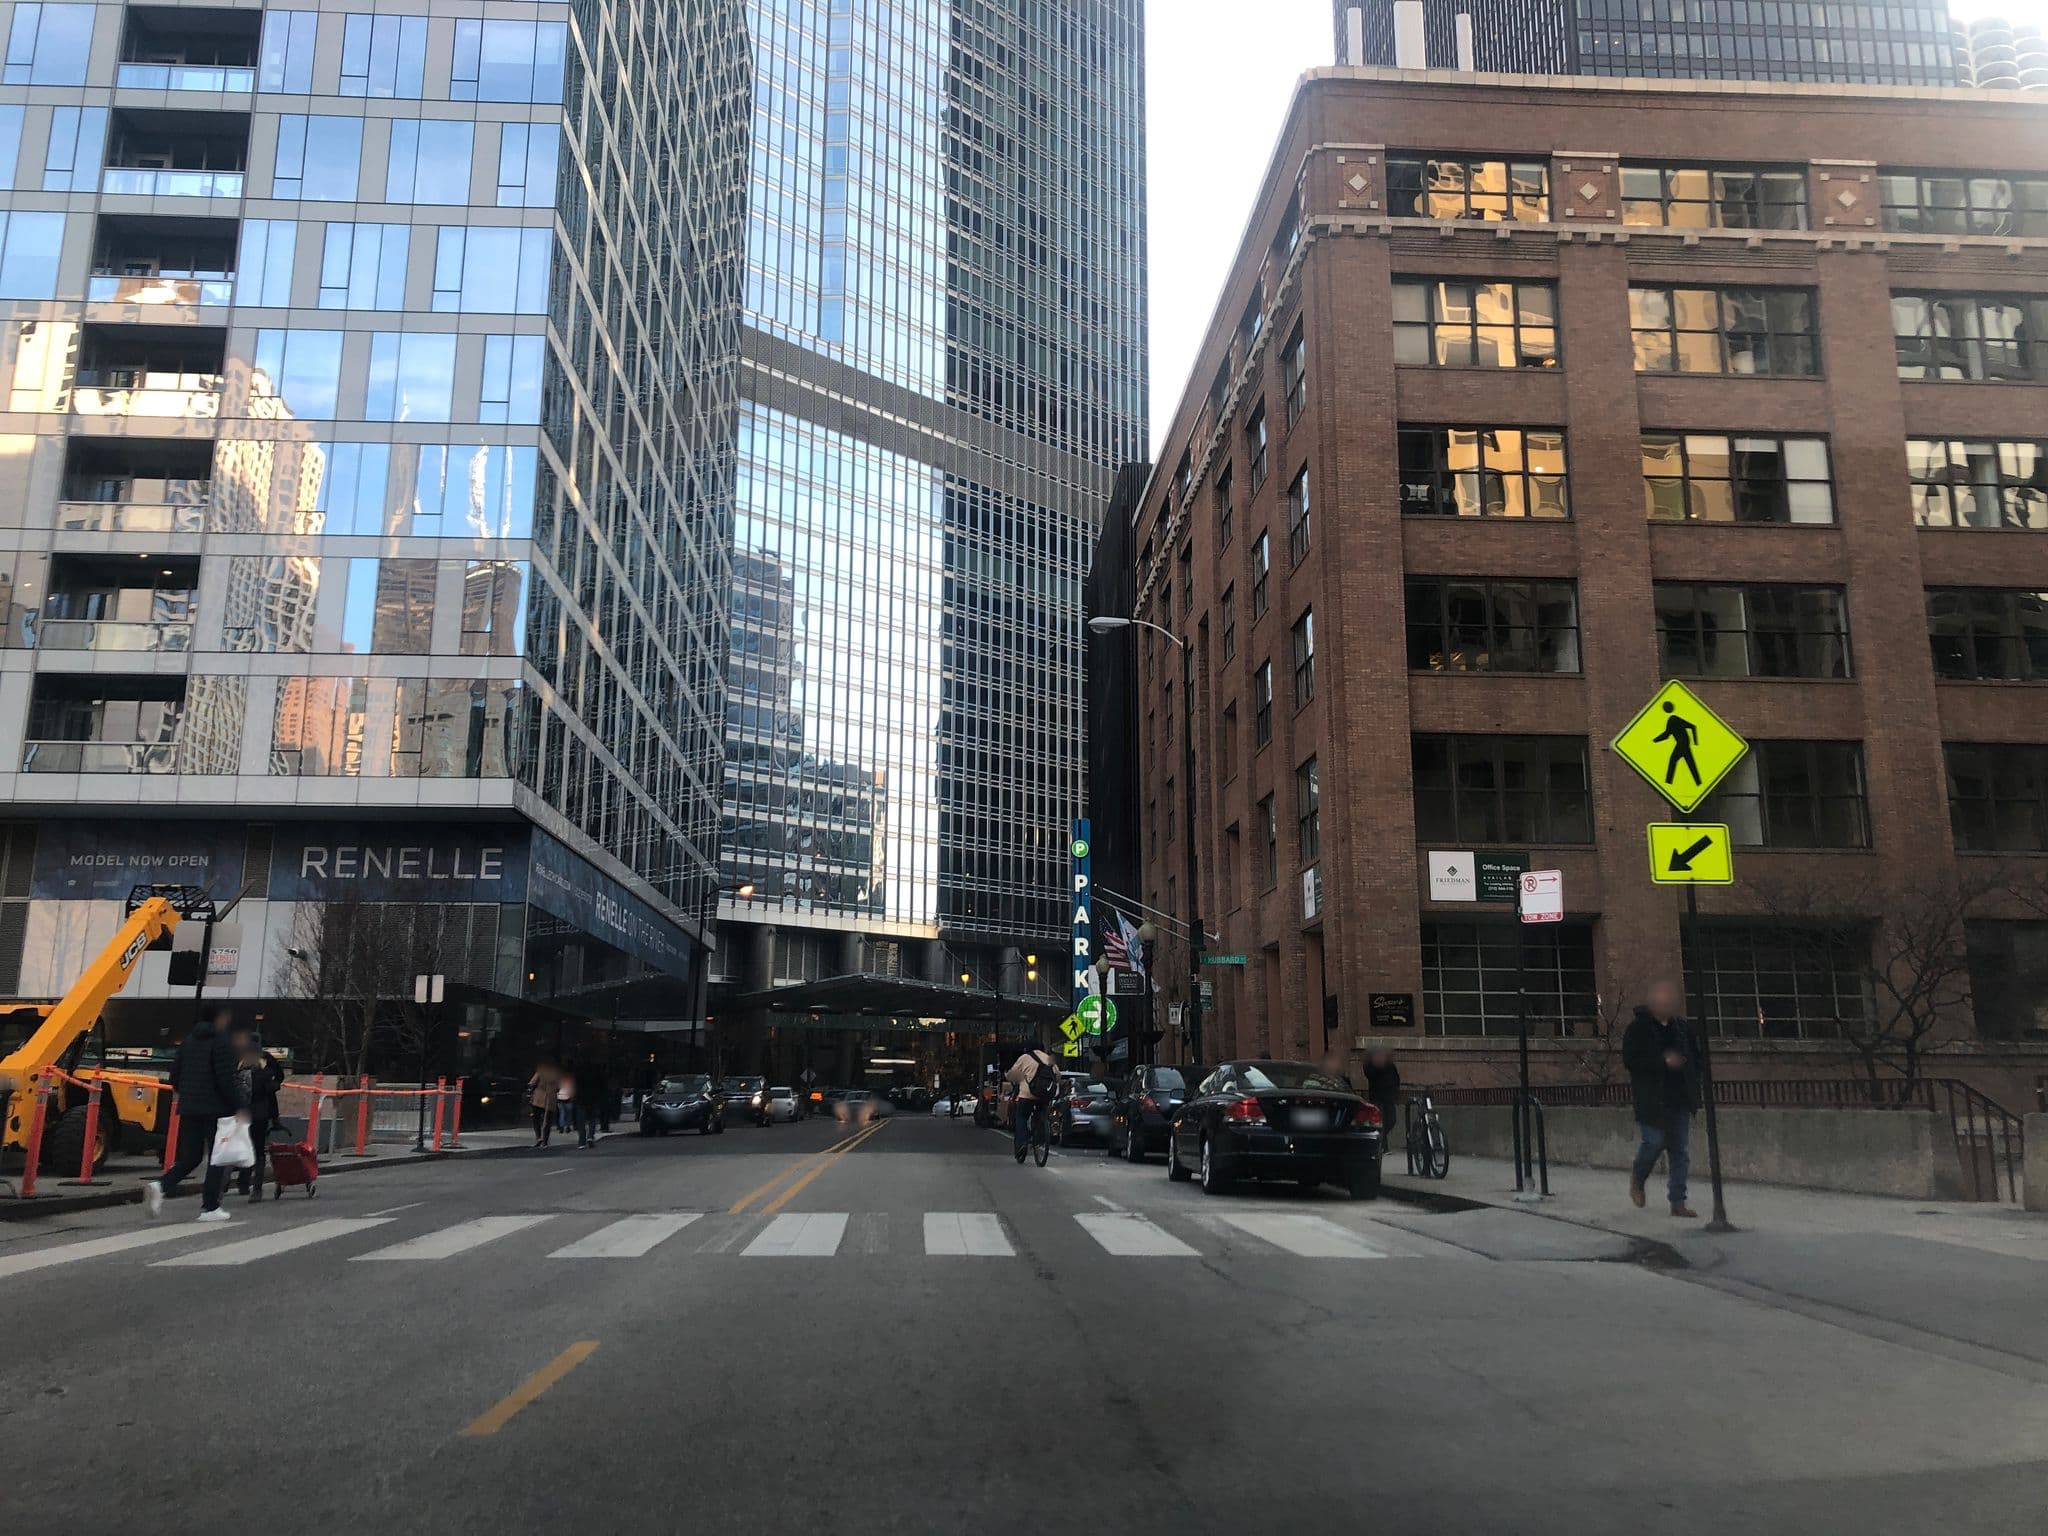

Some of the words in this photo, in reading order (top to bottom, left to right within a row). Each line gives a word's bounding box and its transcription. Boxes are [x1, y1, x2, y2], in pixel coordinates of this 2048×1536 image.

[70, 855, 124, 866] MODEL
[129, 855, 164, 866] NOW
[168, 855, 209, 867] OPEN
[300, 846, 504, 880] RENELLE
[1501, 864, 1521, 872] Space
[595, 890, 628, 934] RENELLE
[1541, 913, 1559, 921] ZONE
[1073, 874, 1090, 988] PARK
[121, 931, 147, 969] JCB
